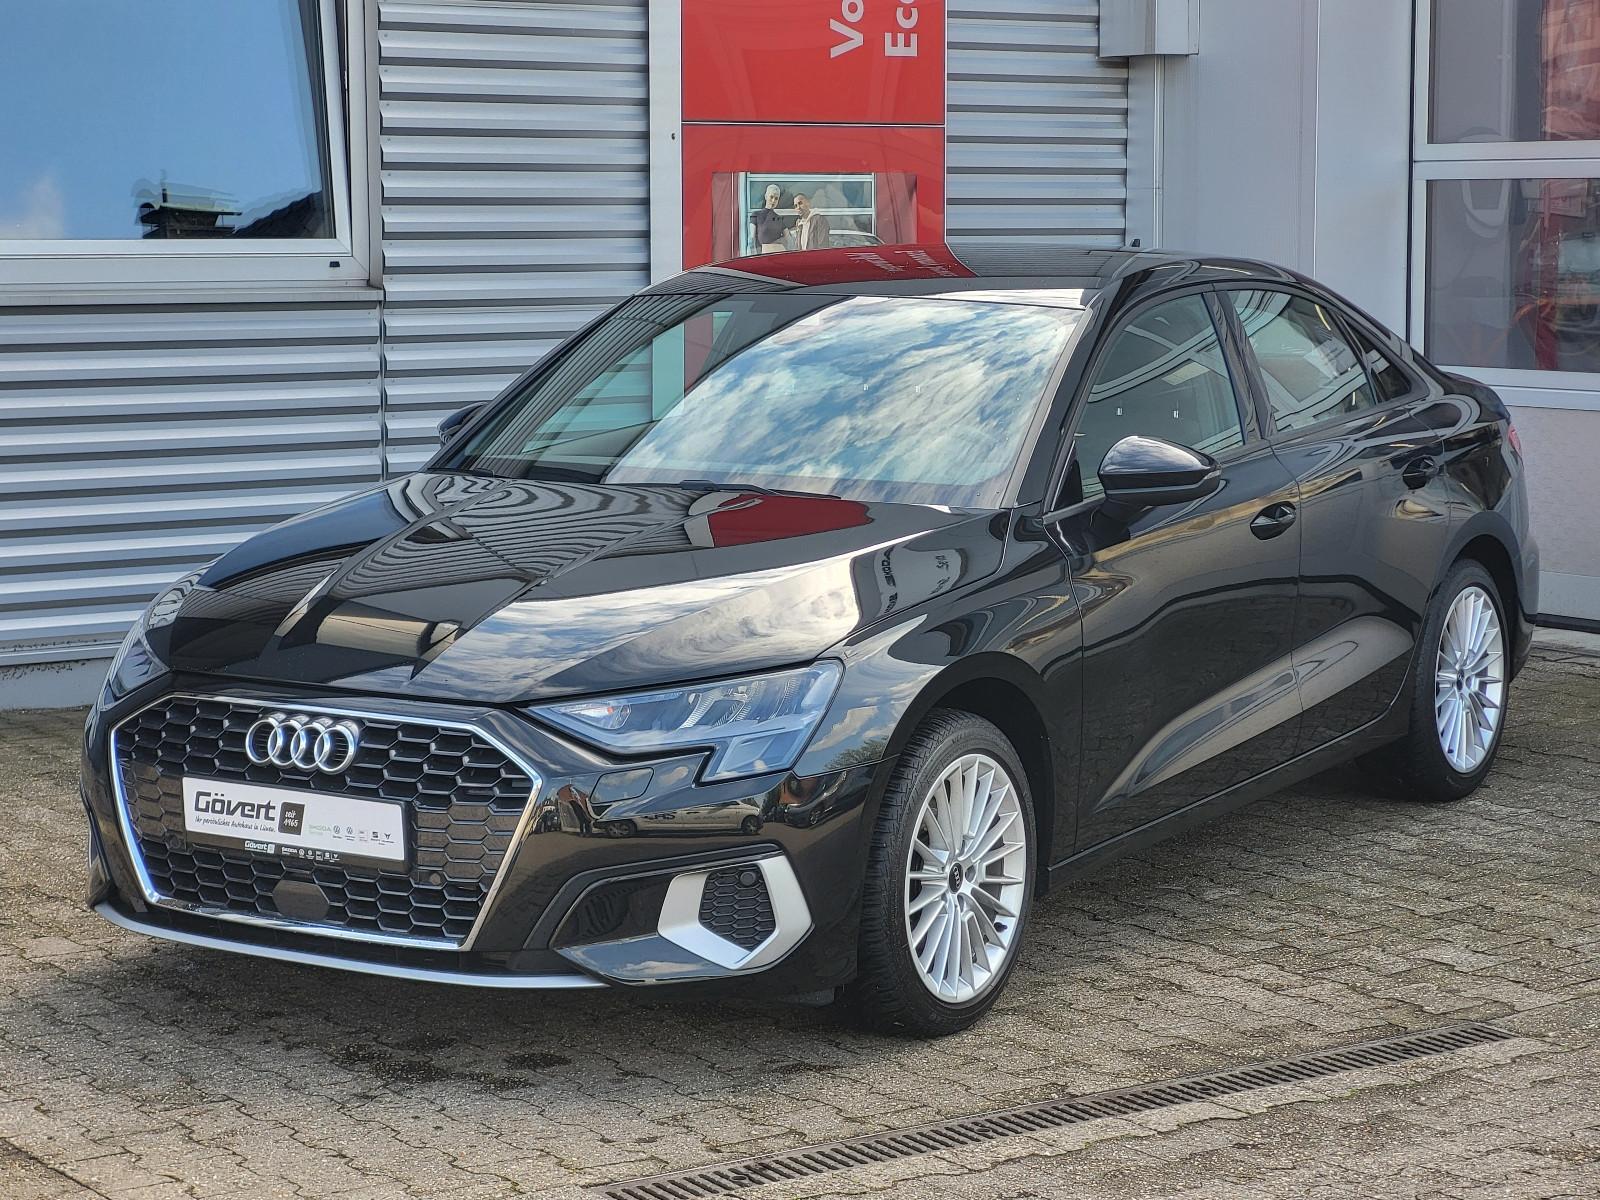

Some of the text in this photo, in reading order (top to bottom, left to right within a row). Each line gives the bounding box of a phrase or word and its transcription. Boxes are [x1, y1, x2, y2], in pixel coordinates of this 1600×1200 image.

[829, 0, 864, 58] Vo
[884, 0, 918, 57] Ec
[194, 790, 276, 822] Gövert
[284, 809, 297, 819] seit
[283, 818, 299, 828] 1965
